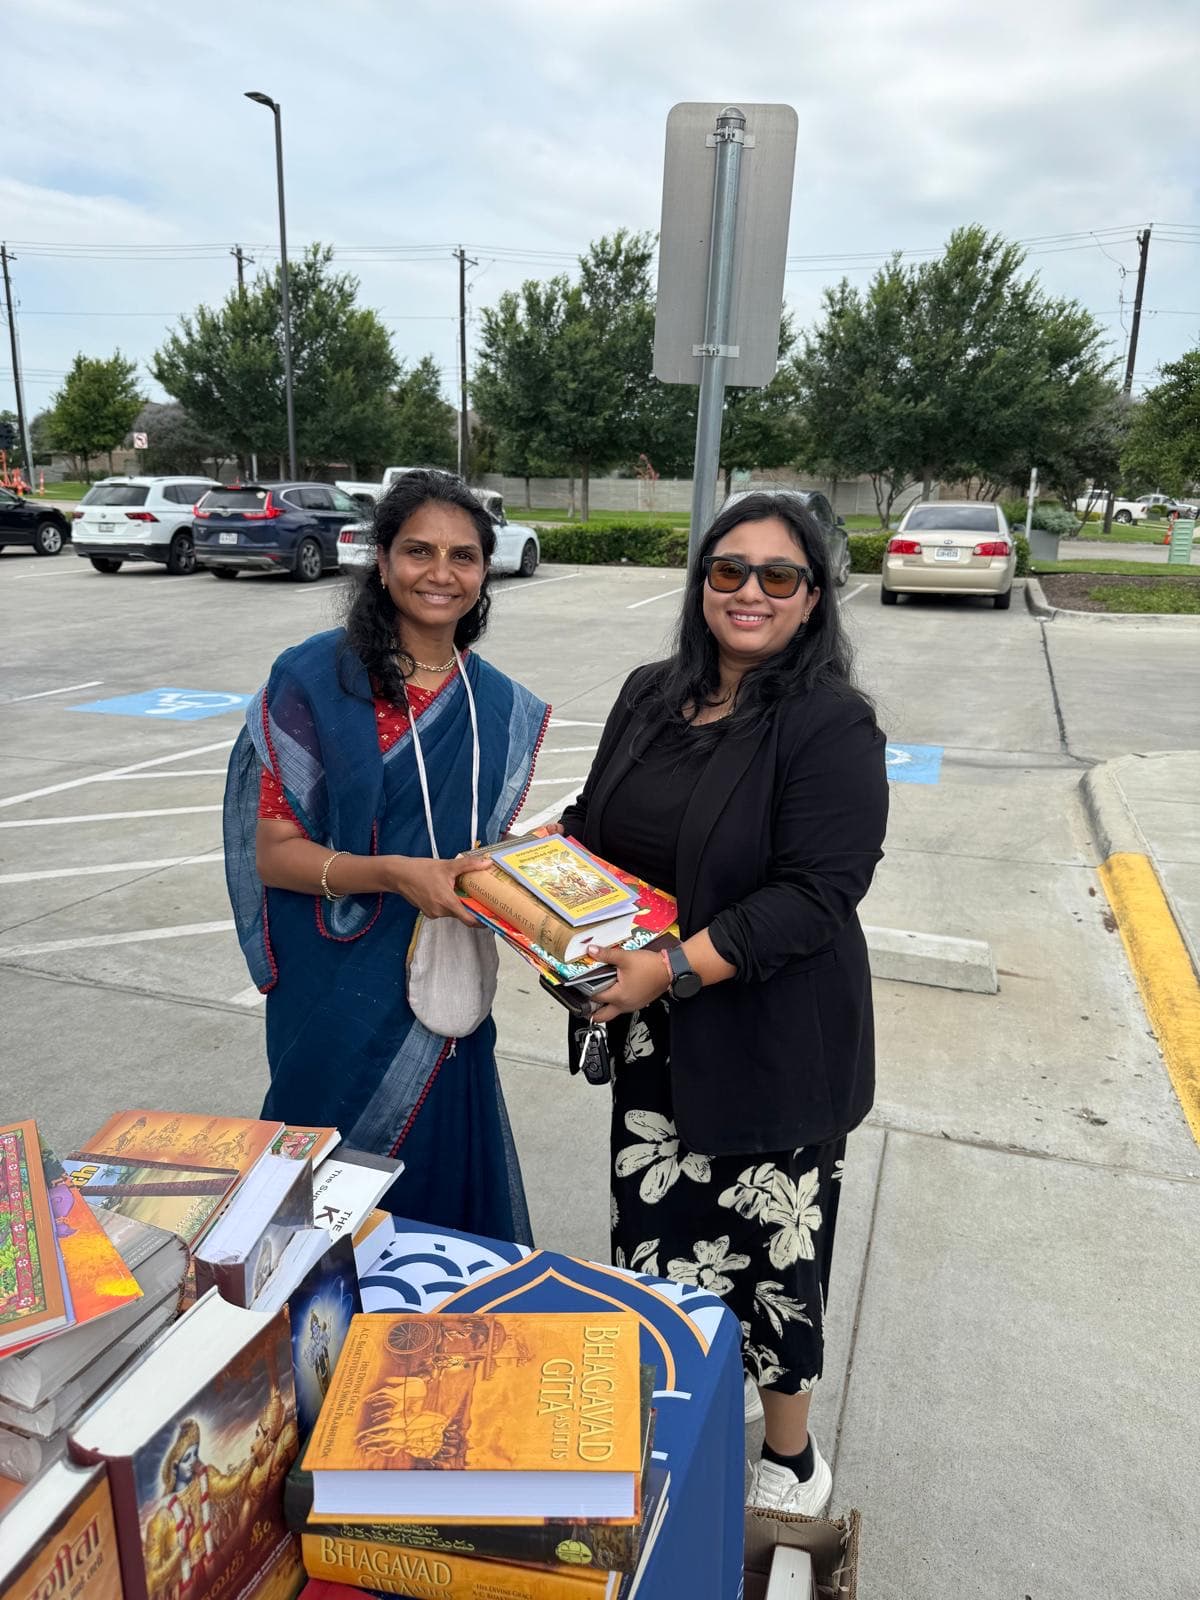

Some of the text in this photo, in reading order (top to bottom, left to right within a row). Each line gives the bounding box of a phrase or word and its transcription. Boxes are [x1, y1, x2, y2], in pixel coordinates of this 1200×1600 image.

[325, 1169, 343, 1184] The
[577, 1325, 621, 1463] BHAGAVAD
[553, 1413, 571, 1430] AS
[552, 1431, 570, 1445] IT
[551, 1448, 569, 1460] IS
[319, 1536, 453, 1587] BHAGAVAD
